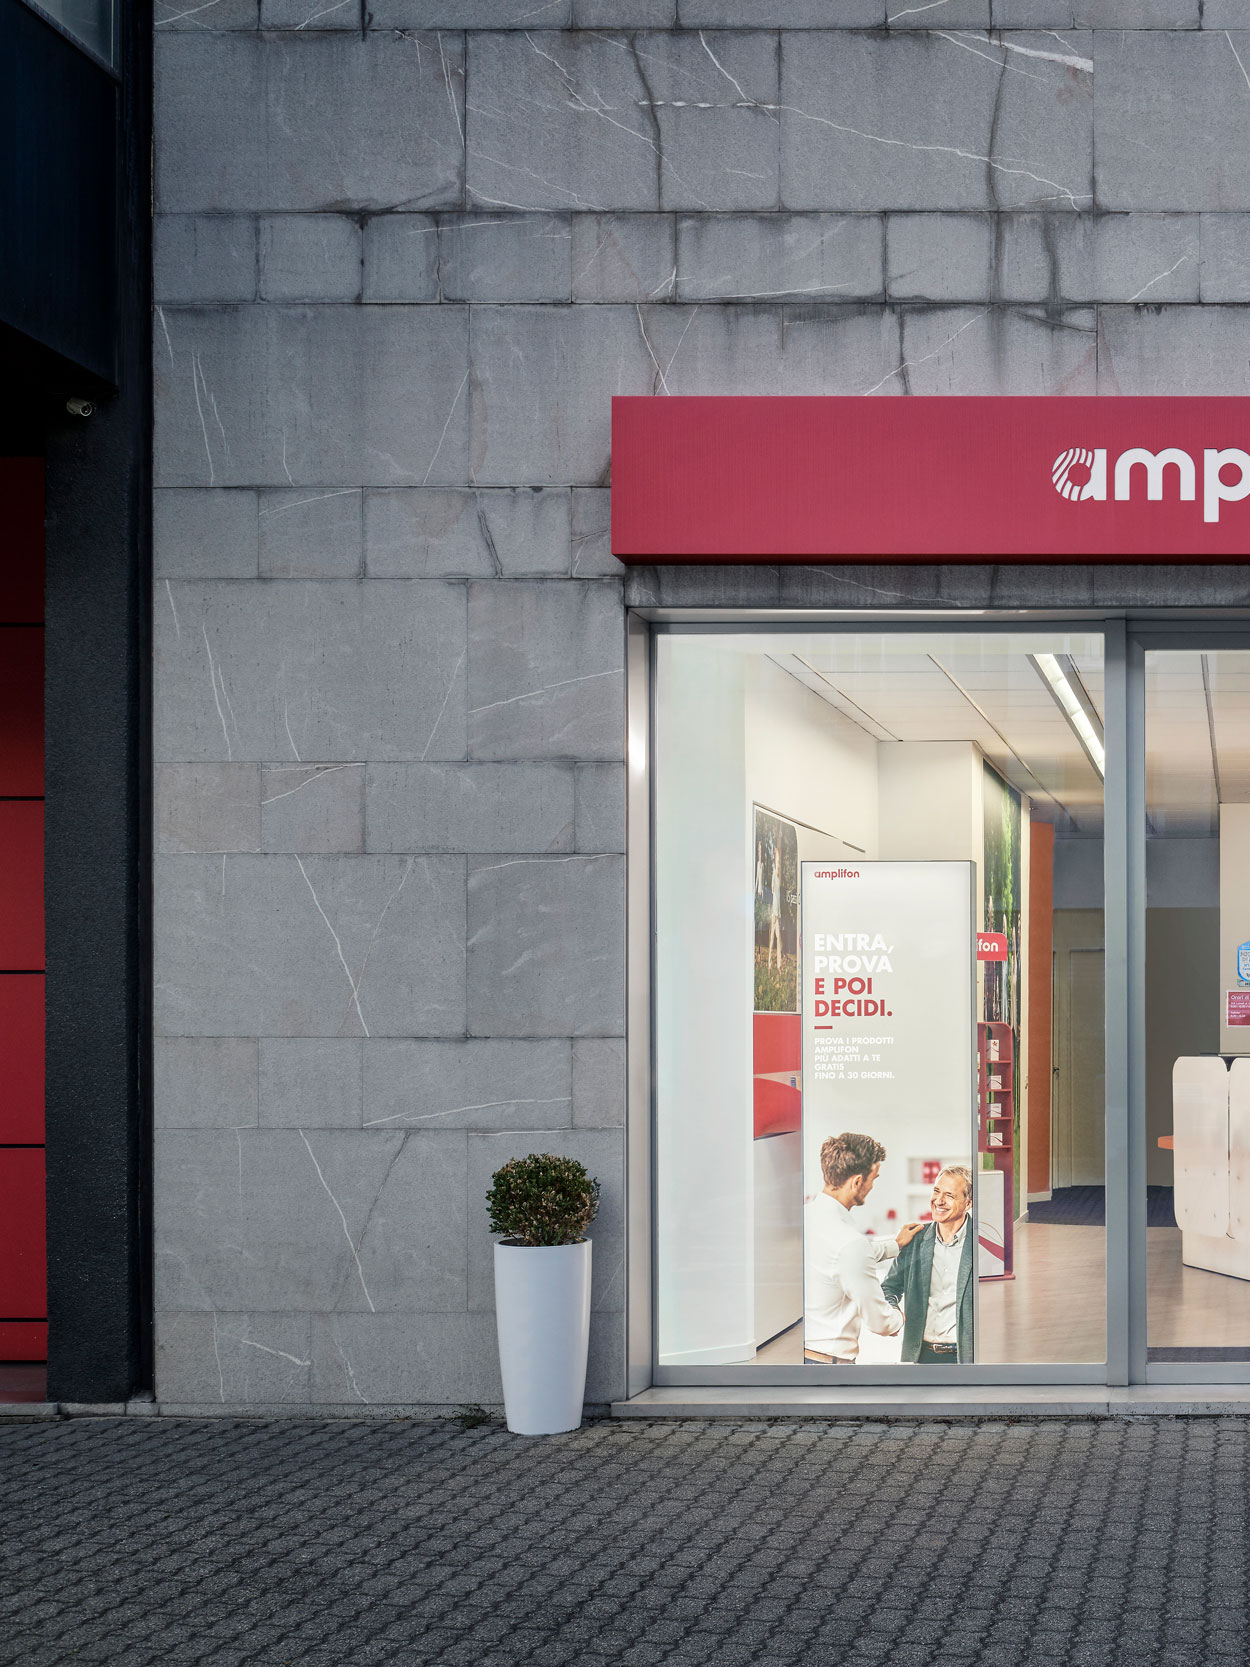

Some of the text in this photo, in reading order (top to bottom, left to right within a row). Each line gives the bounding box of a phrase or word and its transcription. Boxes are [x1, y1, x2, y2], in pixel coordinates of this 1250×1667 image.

[814, 868, 860, 880] amplifon
[814, 933, 895, 954] ENTRA,
[814, 955, 893, 974] PROVA
[814, 976, 873, 995] E POI
[814, 999, 893, 1017] DECIDI.
[814, 1037, 844, 1045] PROVA
[852, 1037, 894, 1045] PRODOTTI
[814, 1045, 859, 1054] AMPLIFON
[814, 1052, 881, 1062] PIÙ ADATTI A TE
[814, 1063, 845, 1071] GRATIS
[814, 1071, 895, 1079] FINO A 30 GIORNI.
